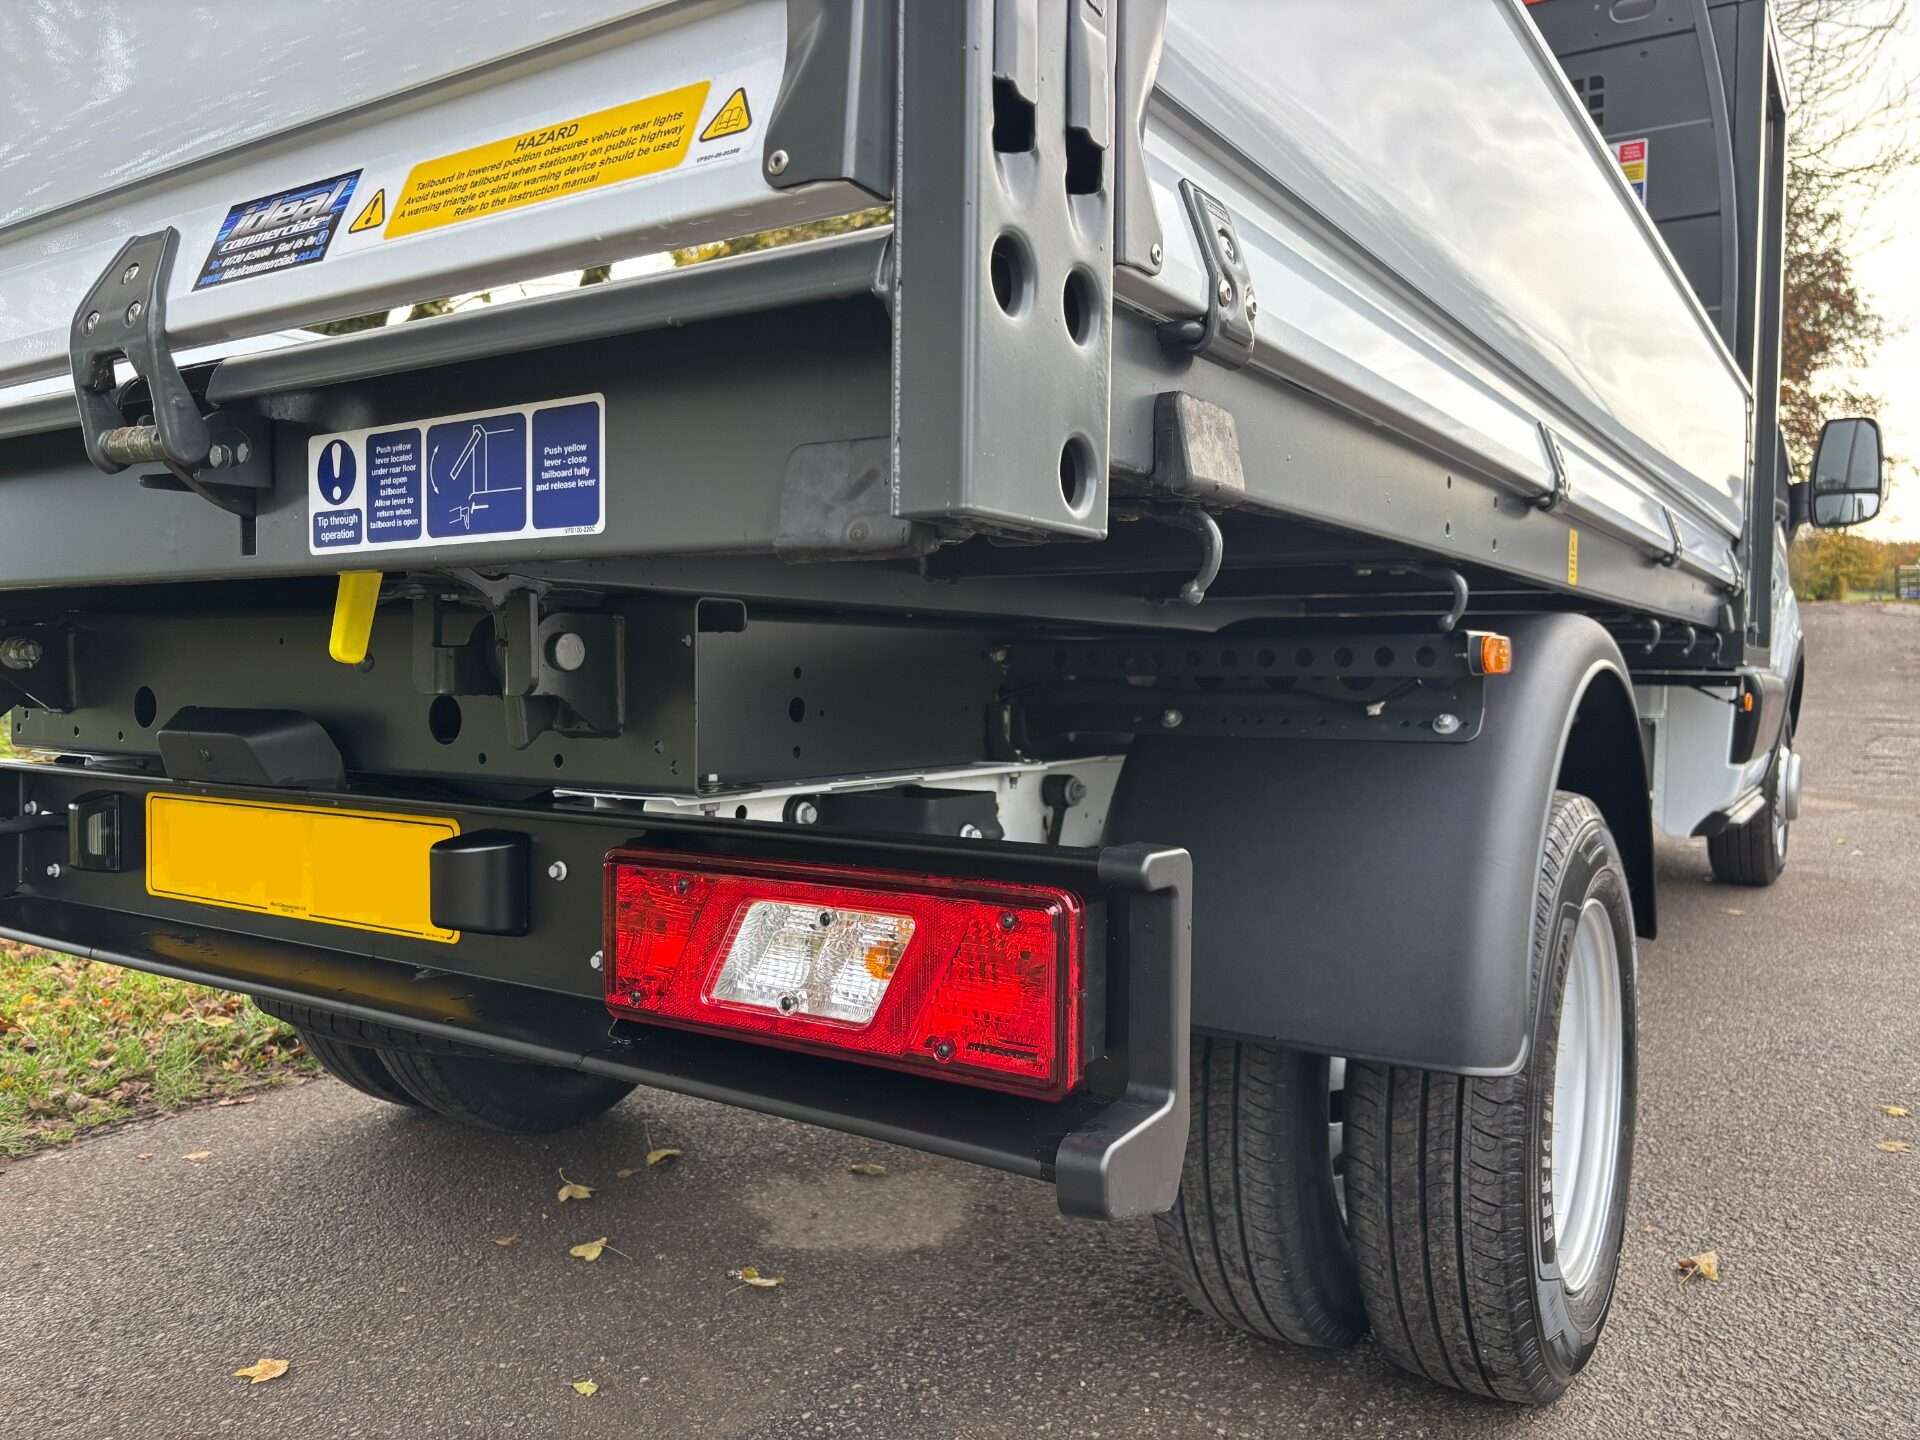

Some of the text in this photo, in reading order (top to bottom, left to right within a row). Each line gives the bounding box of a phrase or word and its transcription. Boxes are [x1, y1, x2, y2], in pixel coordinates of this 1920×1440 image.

[513, 123, 579, 153] HAZARD
[416, 111, 684, 191] Tailboard in lowered position obscures vehicle rear lights
[404, 125, 685, 206] Avoid lowering tailboard when stationary on public highway
[399, 139, 680, 219] A warning triangle or similar warning device should be used
[453, 172, 600, 217] Refer to the instruction manual
[225, 179, 351, 240] ideal
[220, 216, 320, 251] commercials
[376, 443, 412, 455] Push yellow
[544, 443, 588, 456] Push yellow
[375, 453, 413, 465] lever located
[544, 458, 562, 467] lever
[567, 455, 588, 465] close
[371, 468, 388, 476] under
[402, 464, 417, 472] floor
[541, 466, 591, 480] tailboard fully
[380, 476, 408, 486] and open
[535, 478, 596, 492] and release lever
[380, 486, 408, 496] tailboard.
[374, 496, 414, 508] Allow lever to
[376, 507, 412, 518] return when
[317, 513, 358, 529] Tip through
[370, 519, 396, 529] tailboard
[403, 518, 419, 528] open
[320, 528, 355, 543] operation
